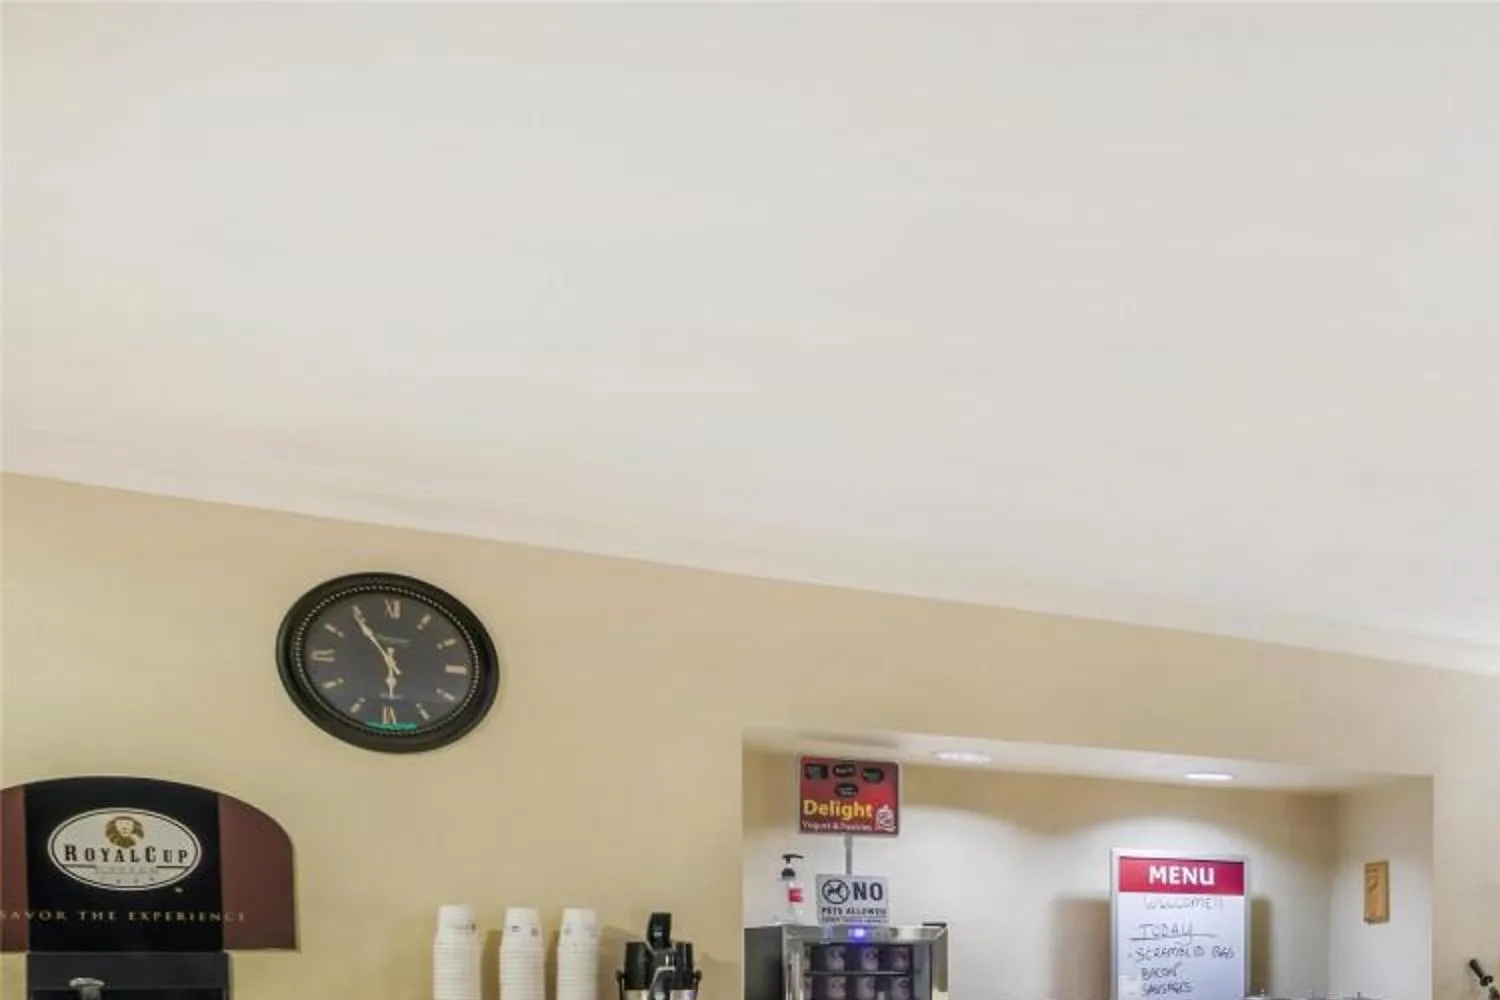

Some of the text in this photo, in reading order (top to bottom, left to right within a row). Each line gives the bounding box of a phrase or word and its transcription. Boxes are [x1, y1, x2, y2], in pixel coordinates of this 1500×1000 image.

[803, 799, 873, 821] Delight
[1149, 865, 1215, 886] MENU
[852, 881, 884, 901] NO
[78, 911, 116, 921] THE
[127, 911, 246, 922] EXPERIENCE
[821, 906, 843, 916] PETS
